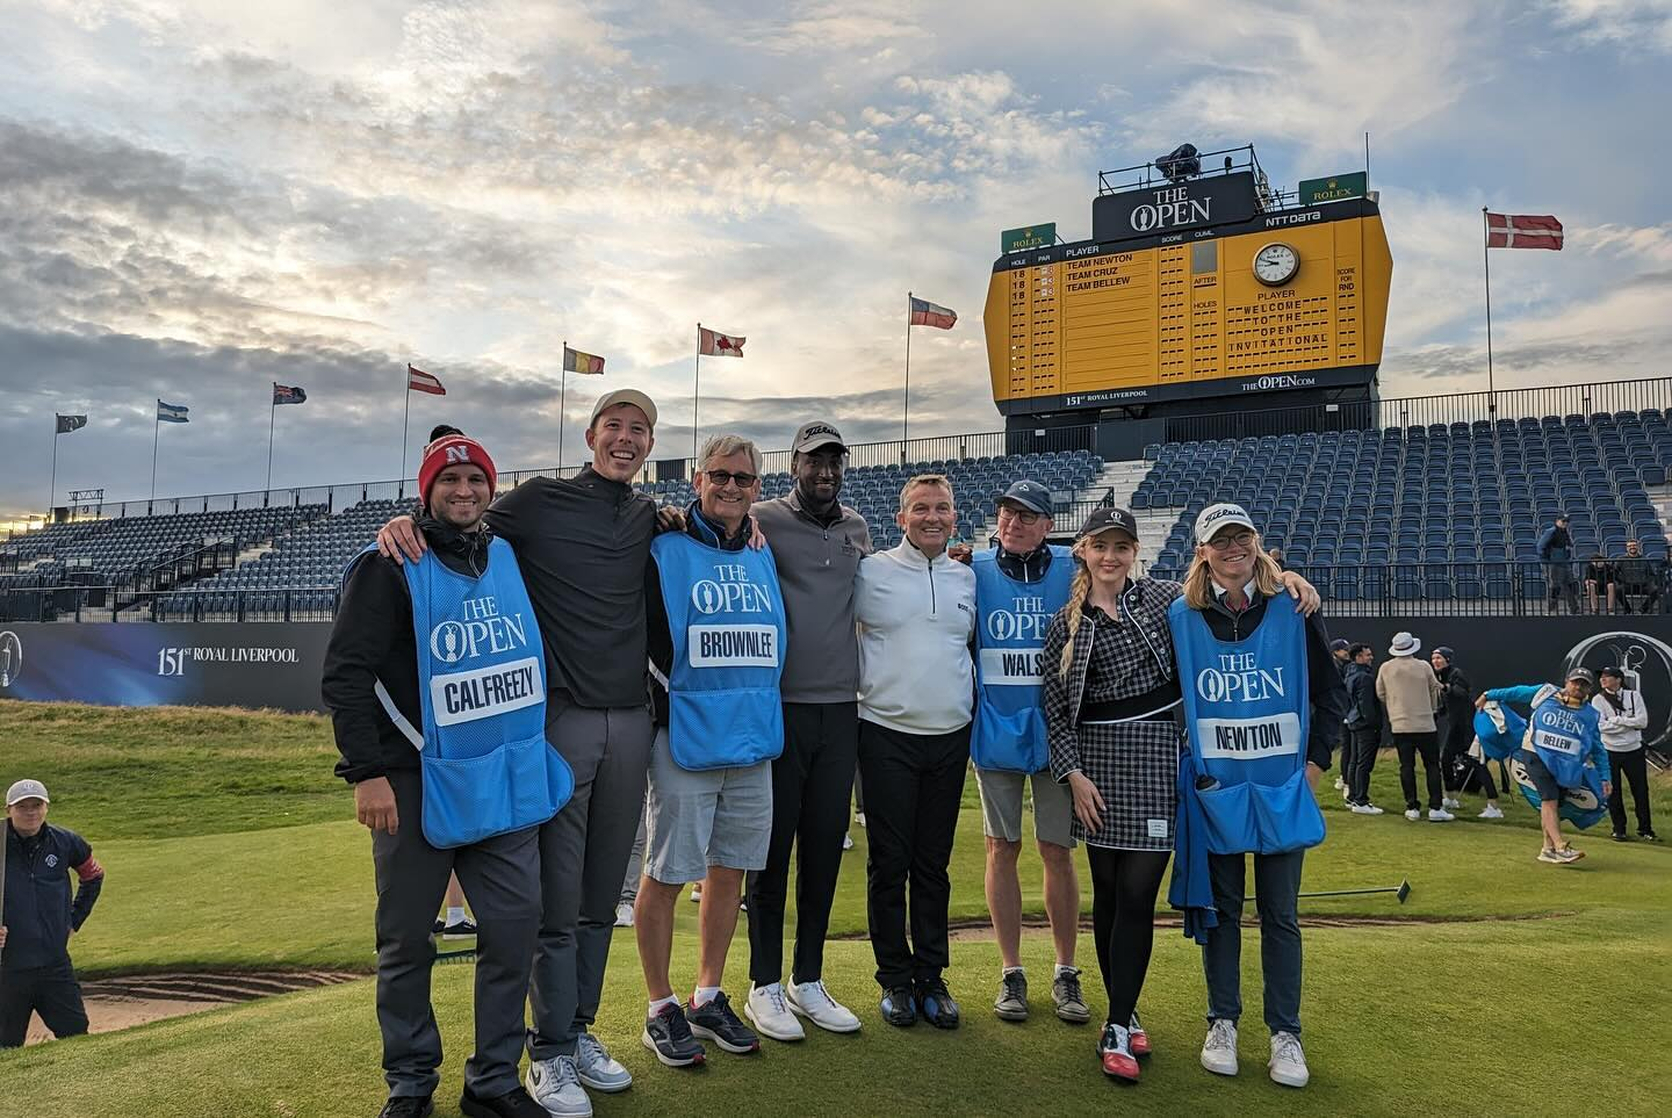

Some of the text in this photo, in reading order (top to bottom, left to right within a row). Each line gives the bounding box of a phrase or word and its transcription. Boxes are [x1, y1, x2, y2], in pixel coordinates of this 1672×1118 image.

[1153, 186, 1188, 205] THE
[1314, 188, 1352, 200] ROLEX
[1131, 196, 1211, 232] OPEN
[1266, 214, 1288, 227] NTT
[1013, 237, 1043, 248] ROLEX
[1066, 245, 1099, 257] PLAYER
[1067, 254, 1133, 270] TEAM NEWTON
[1012, 270, 1025, 279] 18
[1067, 267, 1118, 281] TEAM CRUZ
[1194, 276, 1217, 284] AFTER
[1012, 281, 1025, 289] 18
[1066, 276, 1131, 292] TEAM BELLEW
[1339, 283, 1354, 291] RND
[1012, 291, 1025, 300] 18
[1258, 290, 1295, 300] PLAYER
[1194, 300, 1217, 309] HOLES
[1244, 301, 1301, 314] WELCOME
[1254, 313, 1301, 326] TO THE
[1261, 326, 1293, 336] OPEN
[1228, 334, 1328, 351] INVITATIONAL
[1087, 394, 1108, 402] ROYAL
[1109, 390, 1148, 399] LIVERPOOL
[446, 445, 471, 464] N
[714, 564, 749, 582] THE
[692, 579, 772, 614] OPEN
[462, 596, 499, 621] THE
[1012, 597, 1045, 613] THE
[988, 609, 1055, 640] OPE
[430, 613, 528, 663] OPEN
[701, 631, 773, 658] BROWNLEE
[193, 648, 229, 661] ROYAL
[231, 648, 299, 663] LIVERPOOL
[1218, 652, 1257, 672] THE
[1002, 653, 1044, 677] WALS
[444, 666, 534, 715] CALFREEZY
[1197, 667, 1284, 702] OPEN
[1557, 709, 1576, 720] THE
[1542, 712, 1585, 735] OPEN
[1215, 722, 1282, 751] NEWTON
[1543, 734, 1572, 750] BELLEW
